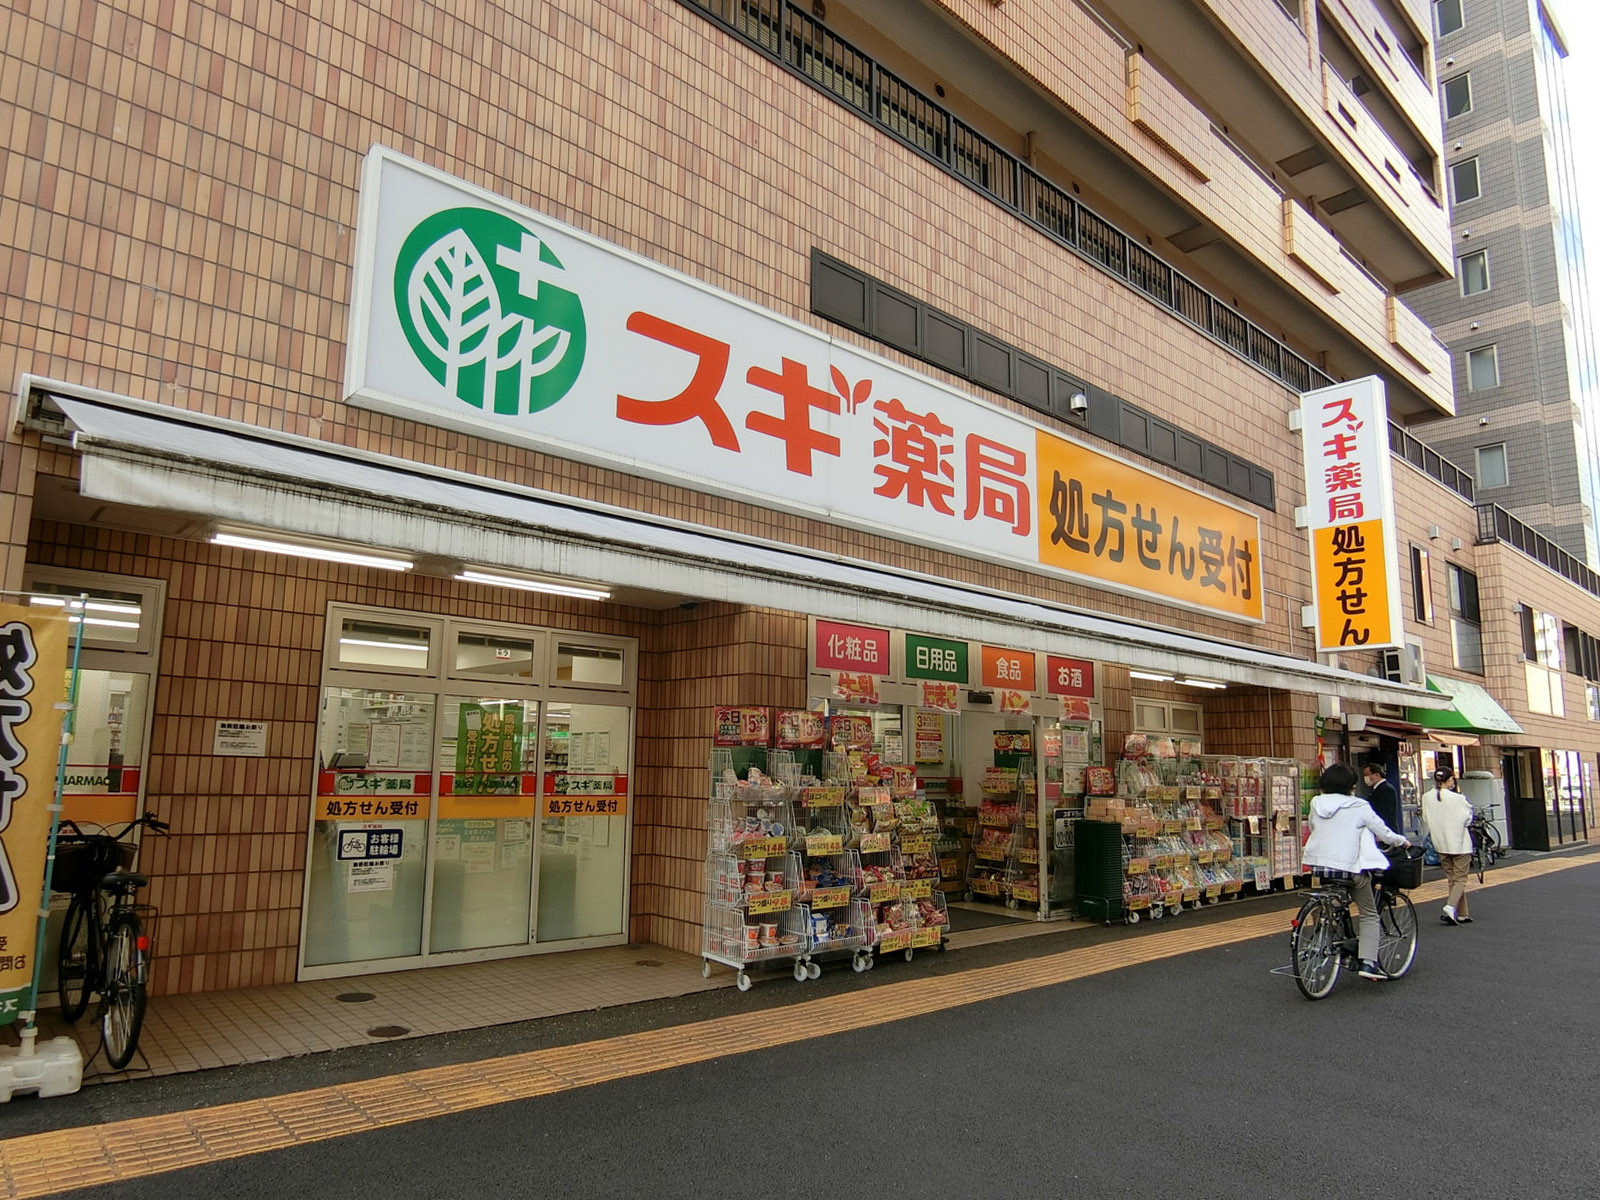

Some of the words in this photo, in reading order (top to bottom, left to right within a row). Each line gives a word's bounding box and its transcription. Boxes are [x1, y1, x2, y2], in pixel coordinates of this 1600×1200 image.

[616, 311, 1031, 538] スギ薬局
[1321, 397, 1366, 524] スギ薬局
[1049, 469, 1253, 600] 処方せん受付
[1331, 525, 1371, 647] 処方せん
[827, 633, 878, 663] 化粧品
[916, 645, 958, 673] 日用品
[995, 657, 1022, 681] 食品
[1057, 666, 1083, 688] お酒
[356, 778, 412, 790] スギ薬局
[571, 779, 613, 790] スギ薬局
[326, 800, 419, 816] 処方せん受付
[548, 799, 618, 814] 処方せん受付
[370, 833, 399, 844] お客様
